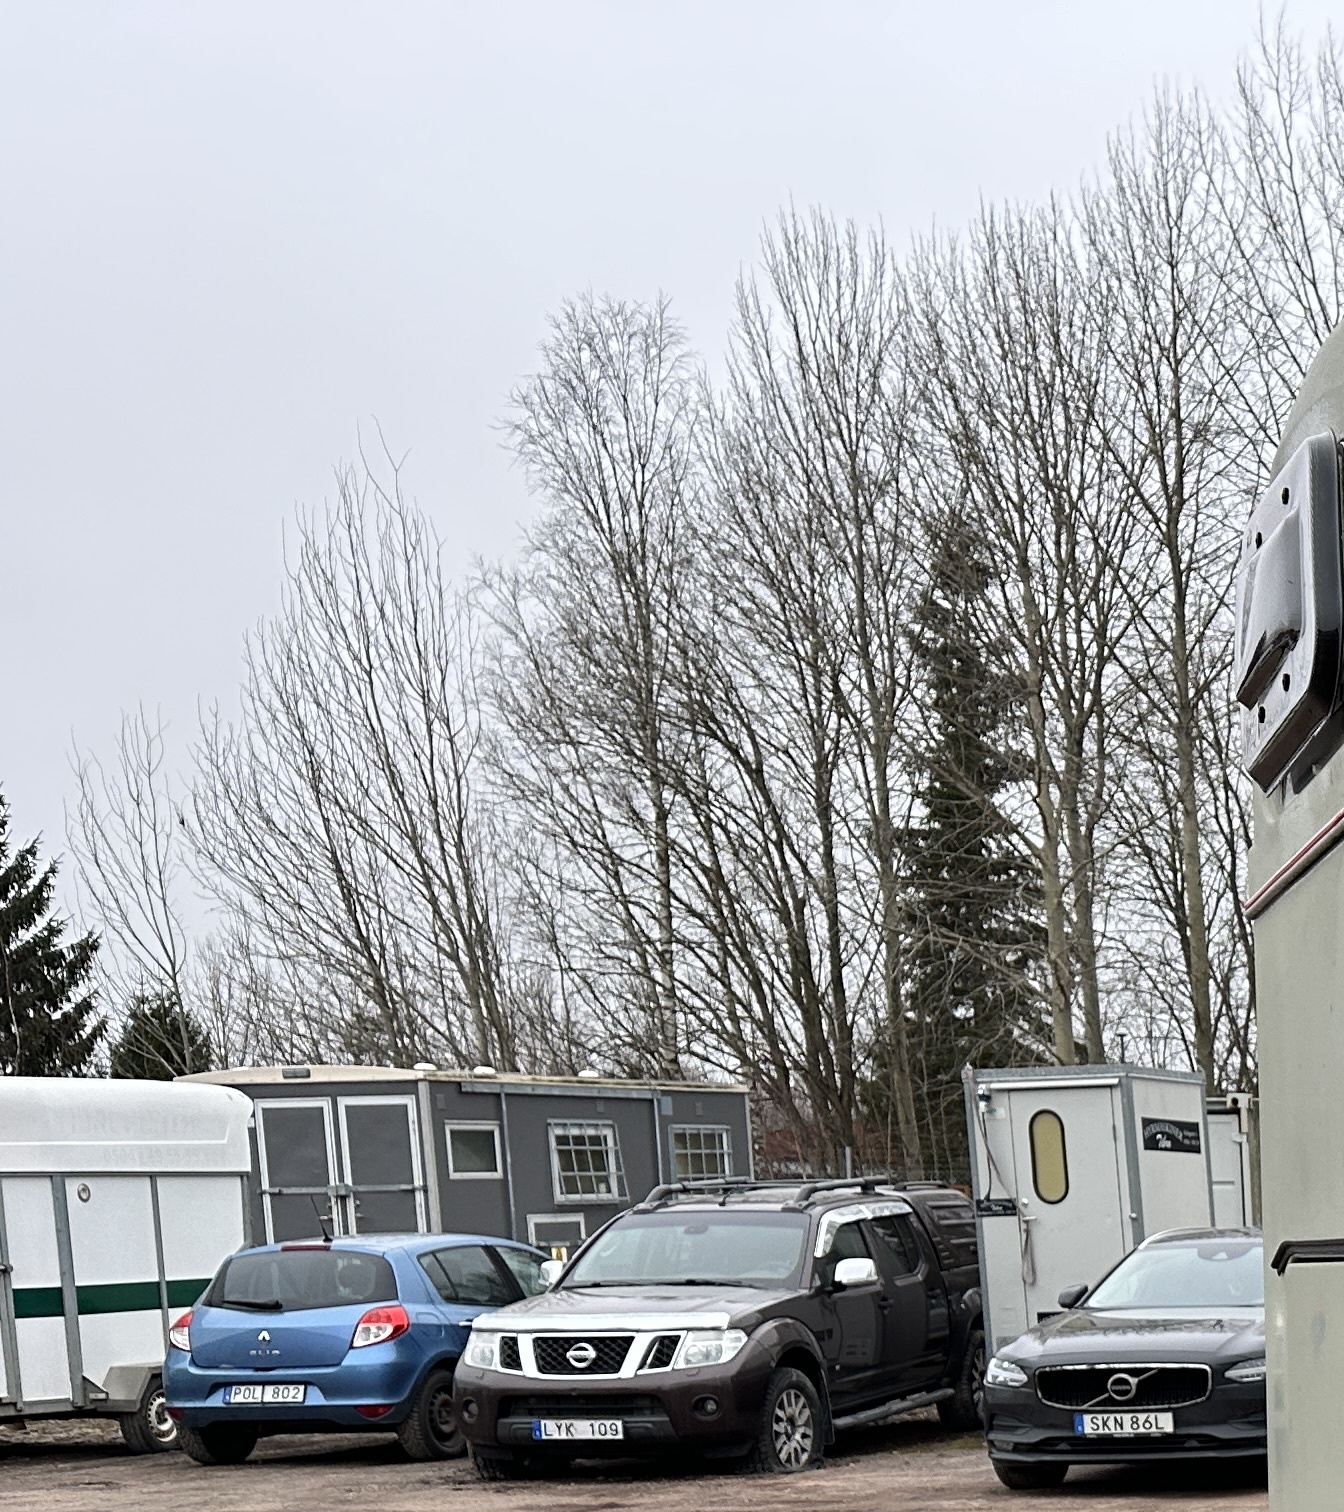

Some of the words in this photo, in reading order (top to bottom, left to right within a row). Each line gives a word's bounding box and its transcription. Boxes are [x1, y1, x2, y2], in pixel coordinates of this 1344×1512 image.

[233, 1386, 259, 1400] POL
[271, 1386, 301, 1400] 802
[543, 1422, 575, 1437] LYK
[589, 1422, 619, 1437] 109
[1090, 1415, 1124, 1431] SKN
[1130, 1414, 1165, 1431] 86L
